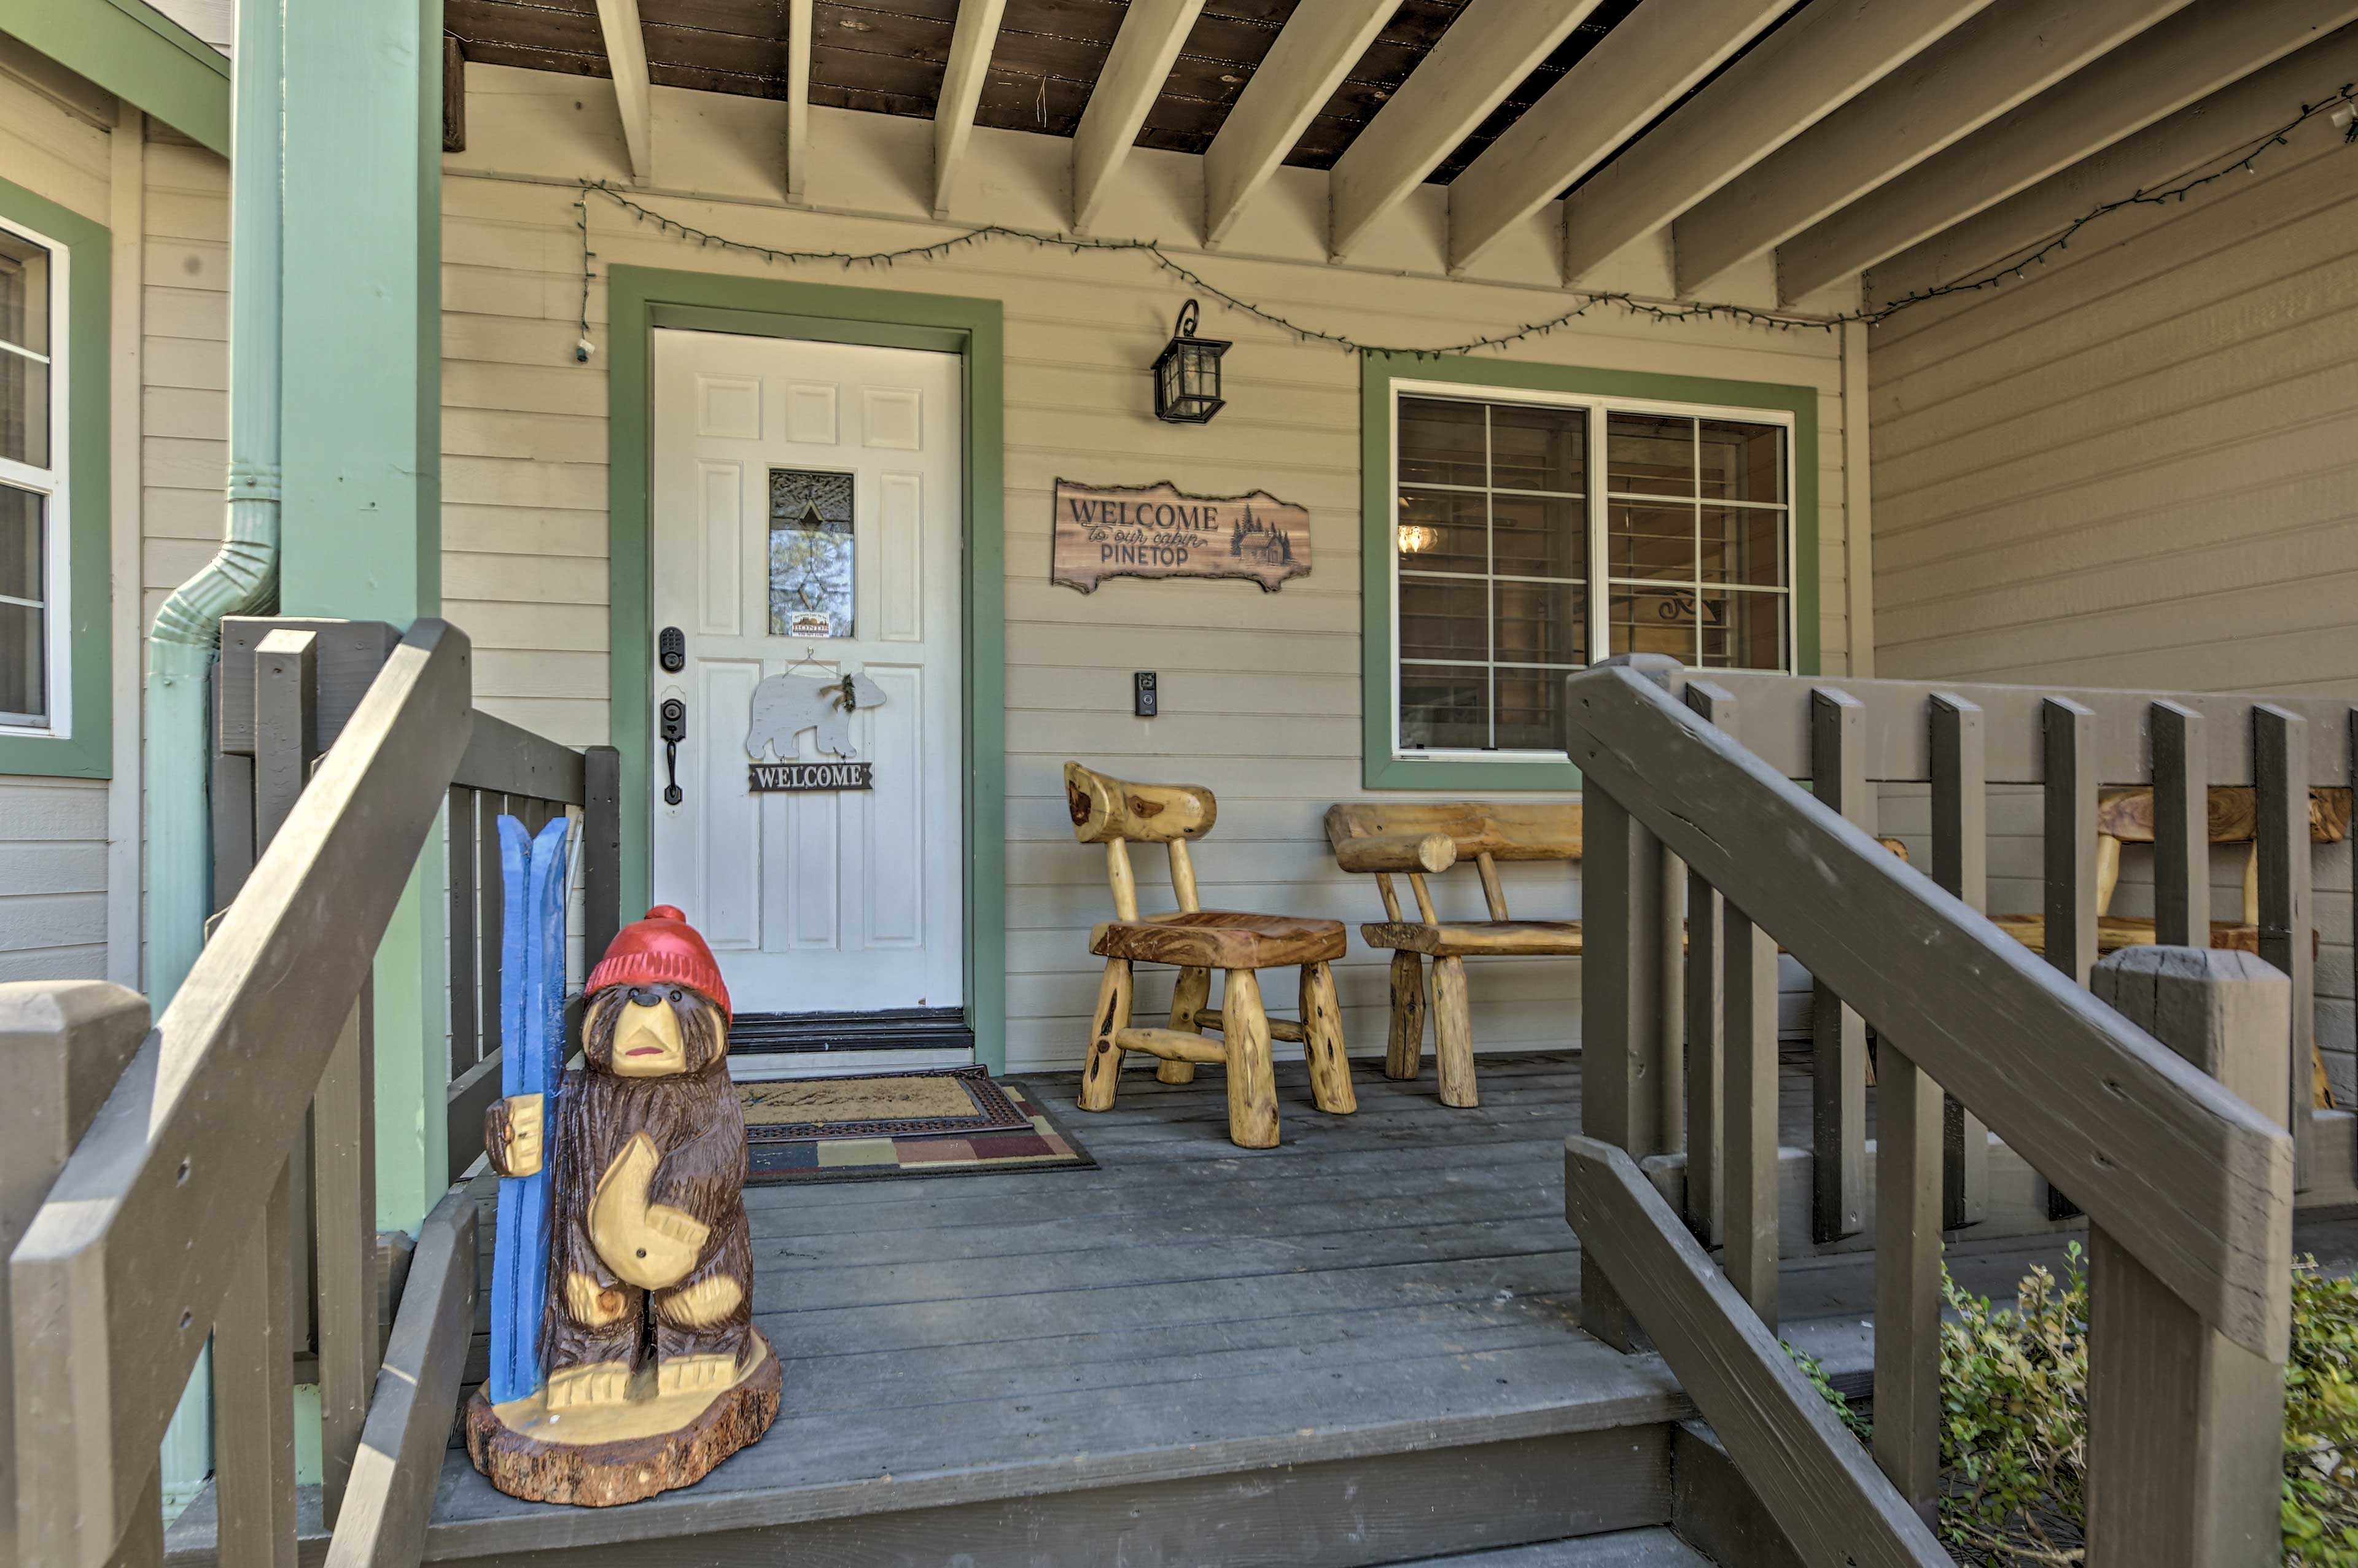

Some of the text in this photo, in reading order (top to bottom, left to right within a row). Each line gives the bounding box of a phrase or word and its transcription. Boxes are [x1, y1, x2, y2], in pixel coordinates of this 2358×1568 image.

[1070, 499, 1219, 531] WELCOME
[1081, 524, 1208, 548] to our cabin
[1101, 543, 1189, 567] PINETOP
[756, 764, 862, 789] WELCOME
